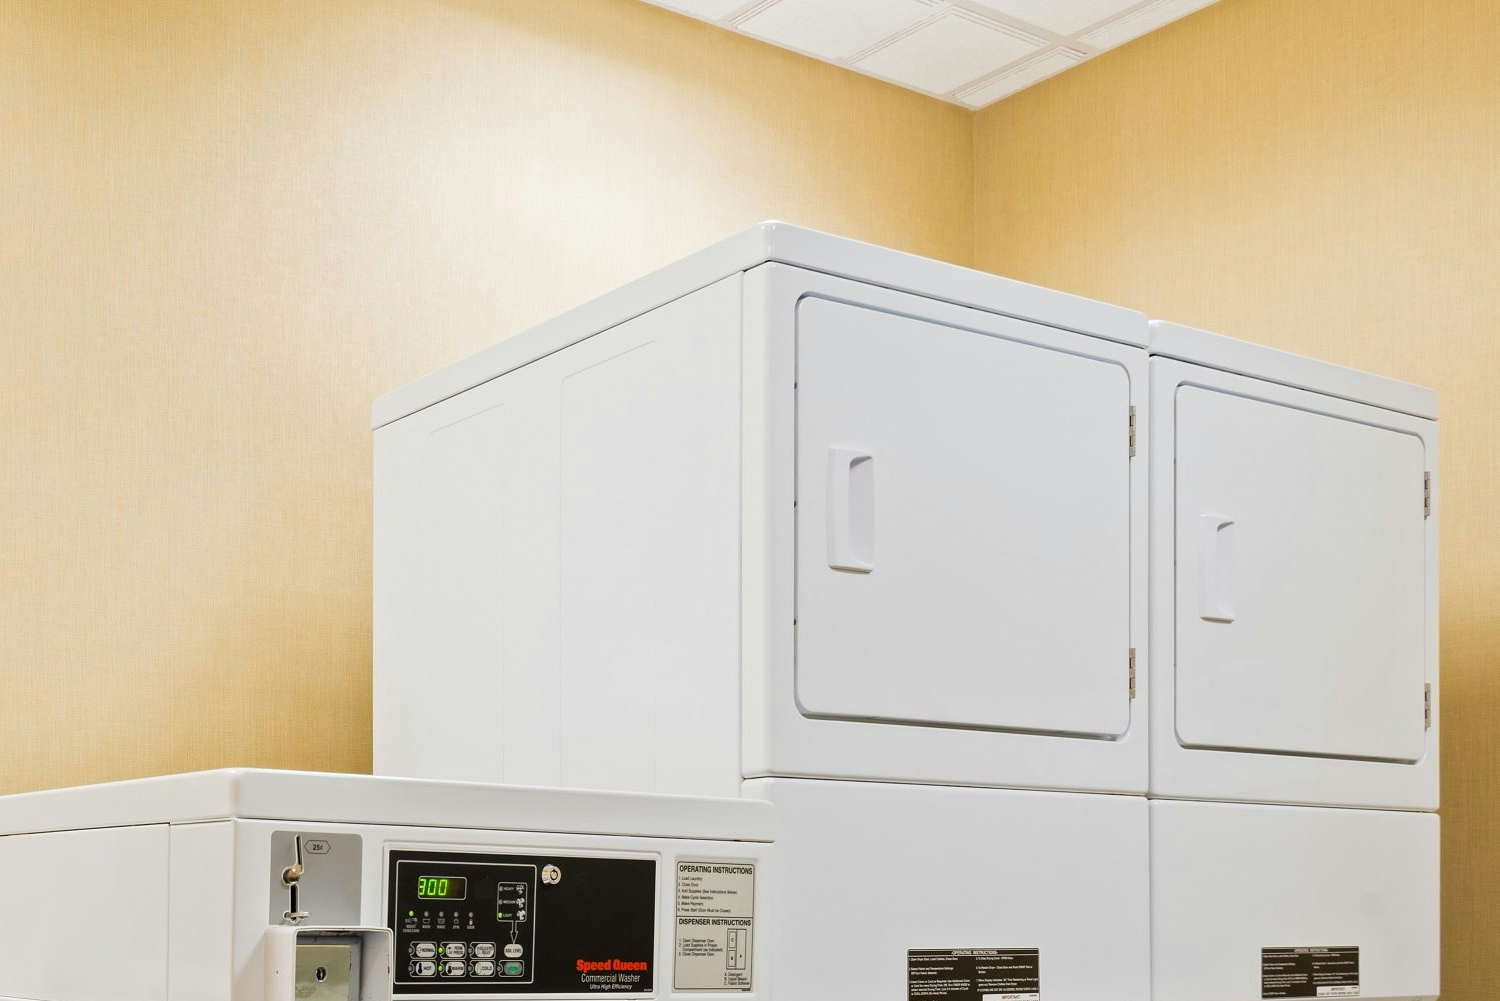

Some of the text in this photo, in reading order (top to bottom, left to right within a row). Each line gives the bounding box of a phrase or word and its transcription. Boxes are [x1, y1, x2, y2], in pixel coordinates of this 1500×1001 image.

[679, 865, 753, 875] OPERATING INSTRUCTIONS
[576, 959, 647, 973] Speed Queen
[581, 973, 641, 983] Commercial Washer
